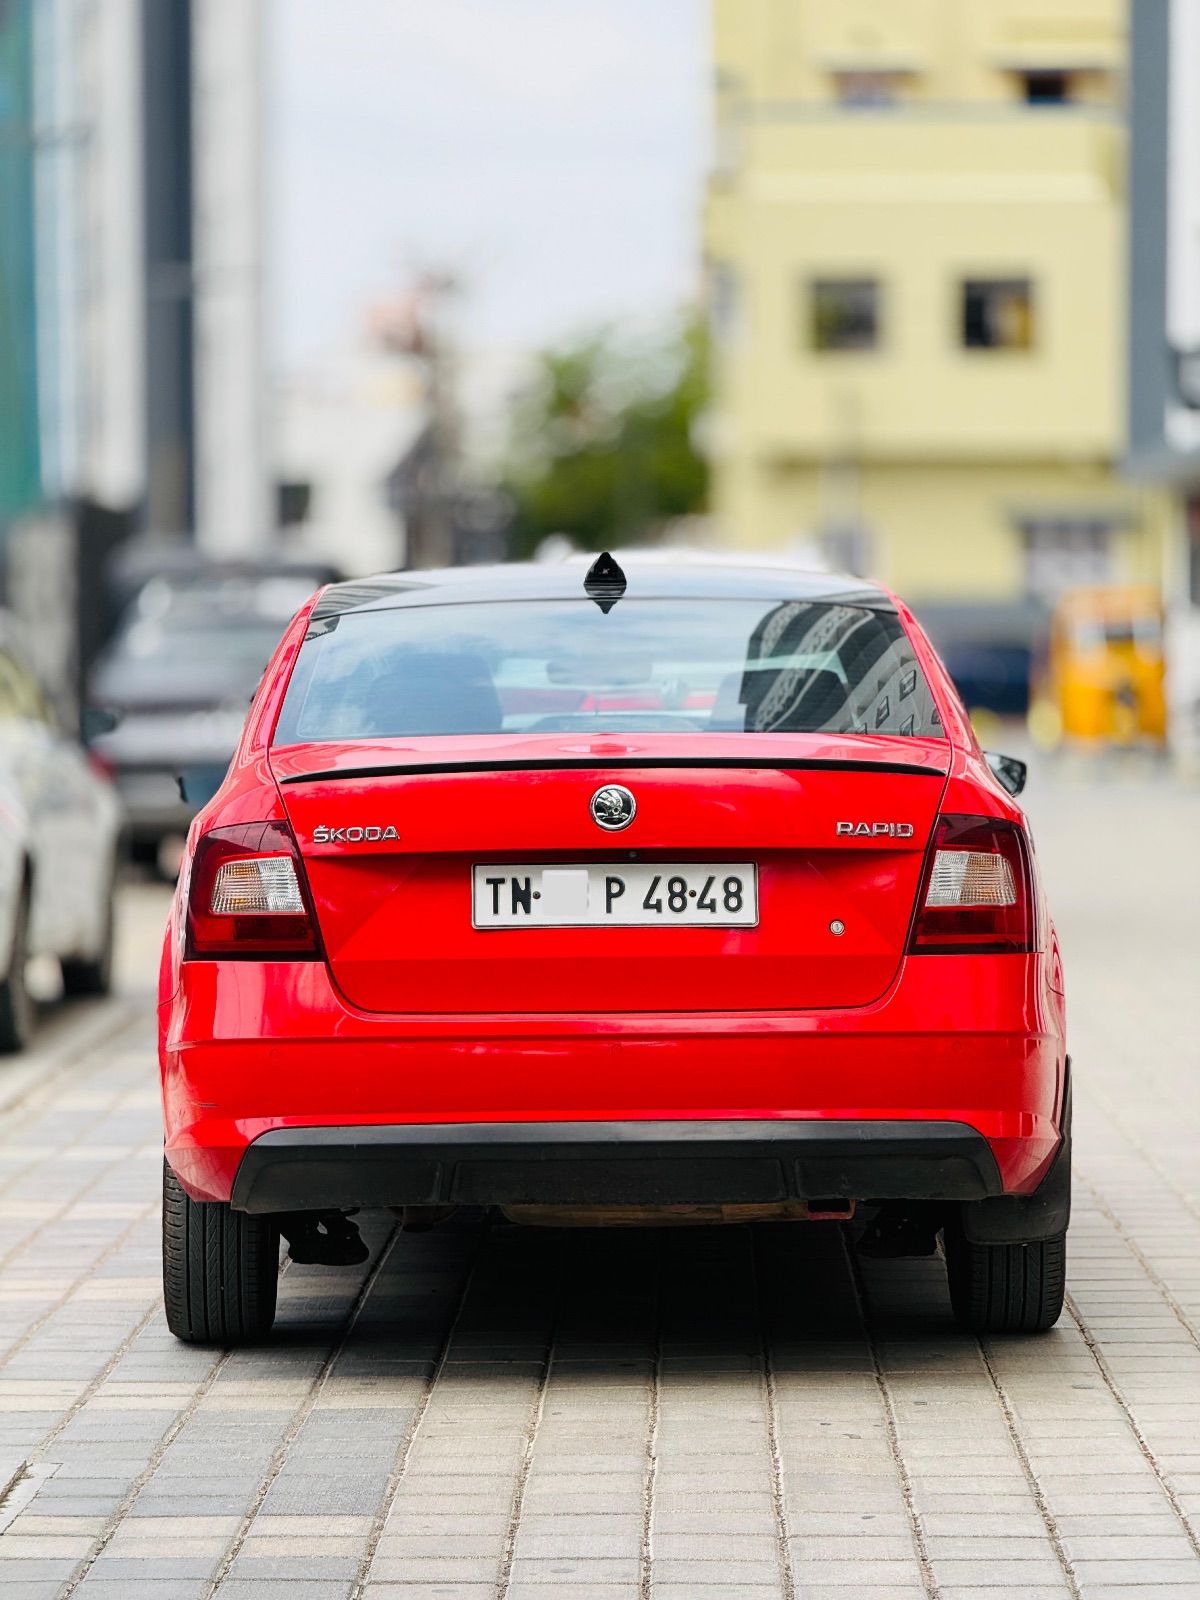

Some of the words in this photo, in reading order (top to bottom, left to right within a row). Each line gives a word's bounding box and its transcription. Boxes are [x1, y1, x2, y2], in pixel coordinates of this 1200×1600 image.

[313, 825, 400, 843] ŠKODA
[836, 822, 914, 837] RAPID
[485, 876, 532, 915] TN
[604, 876, 626, 914] P
